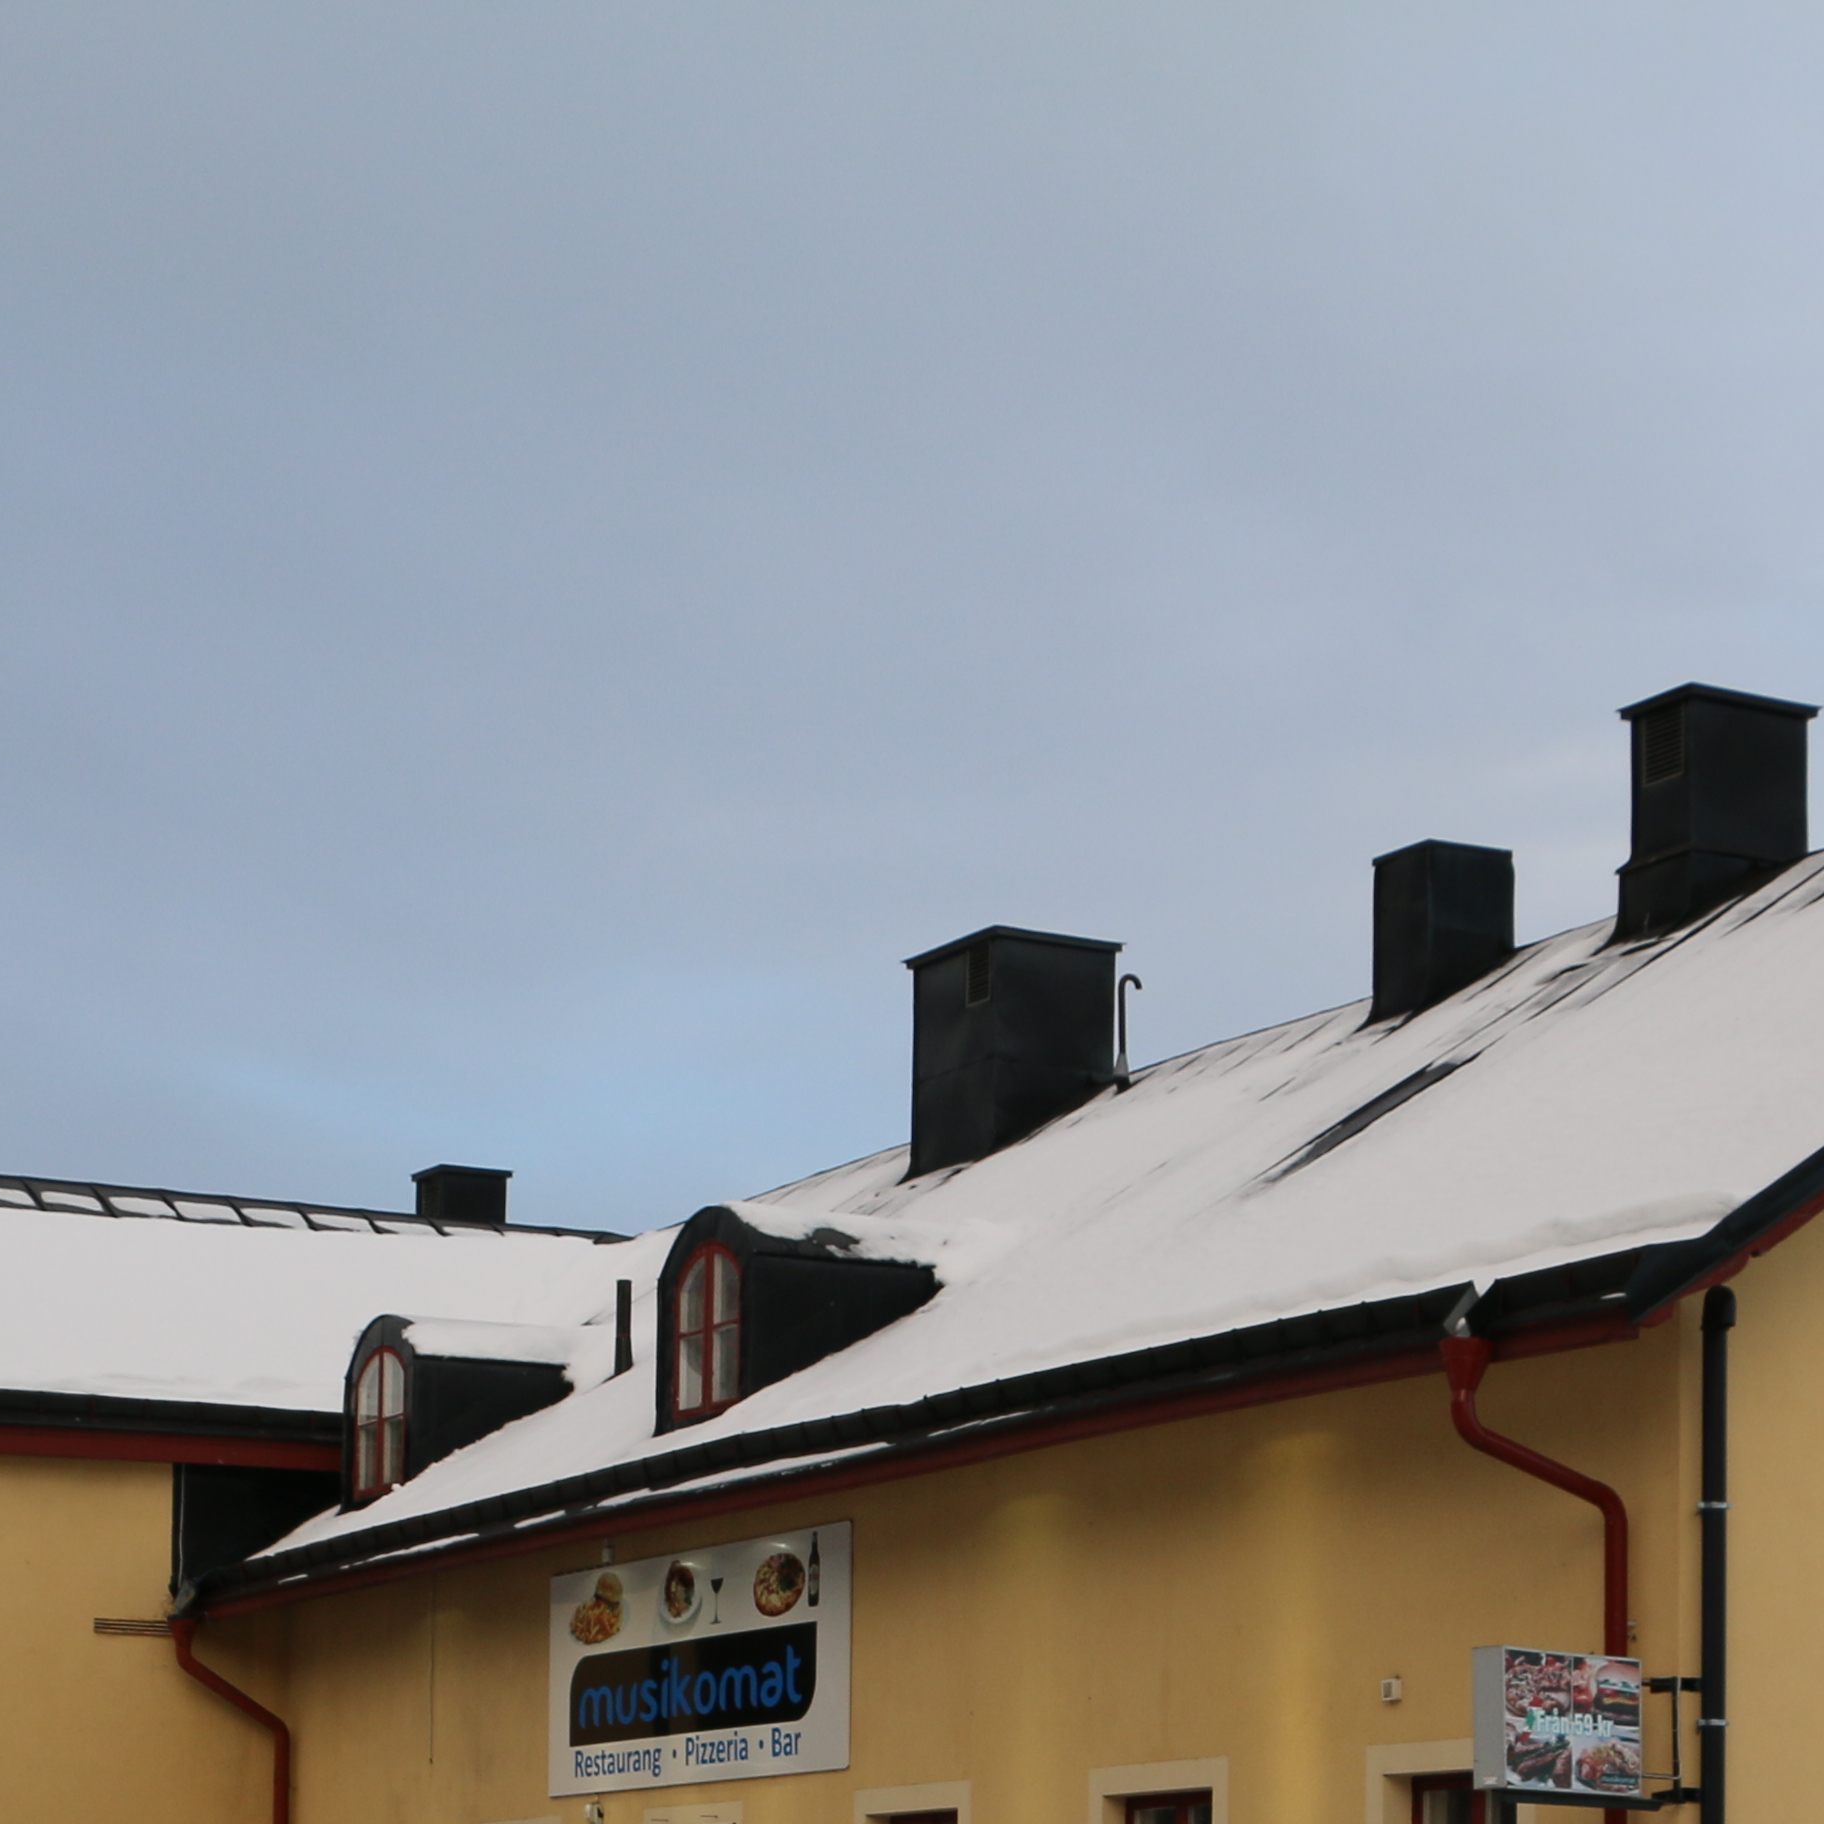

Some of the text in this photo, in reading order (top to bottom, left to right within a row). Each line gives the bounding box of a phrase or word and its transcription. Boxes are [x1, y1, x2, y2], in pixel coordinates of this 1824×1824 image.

[578, 1644, 803, 1729] musikomat
[1536, 1707, 1615, 1738] Från 59 kr
[574, 1727, 802, 1779] Restaurang Pizzeria Bar
